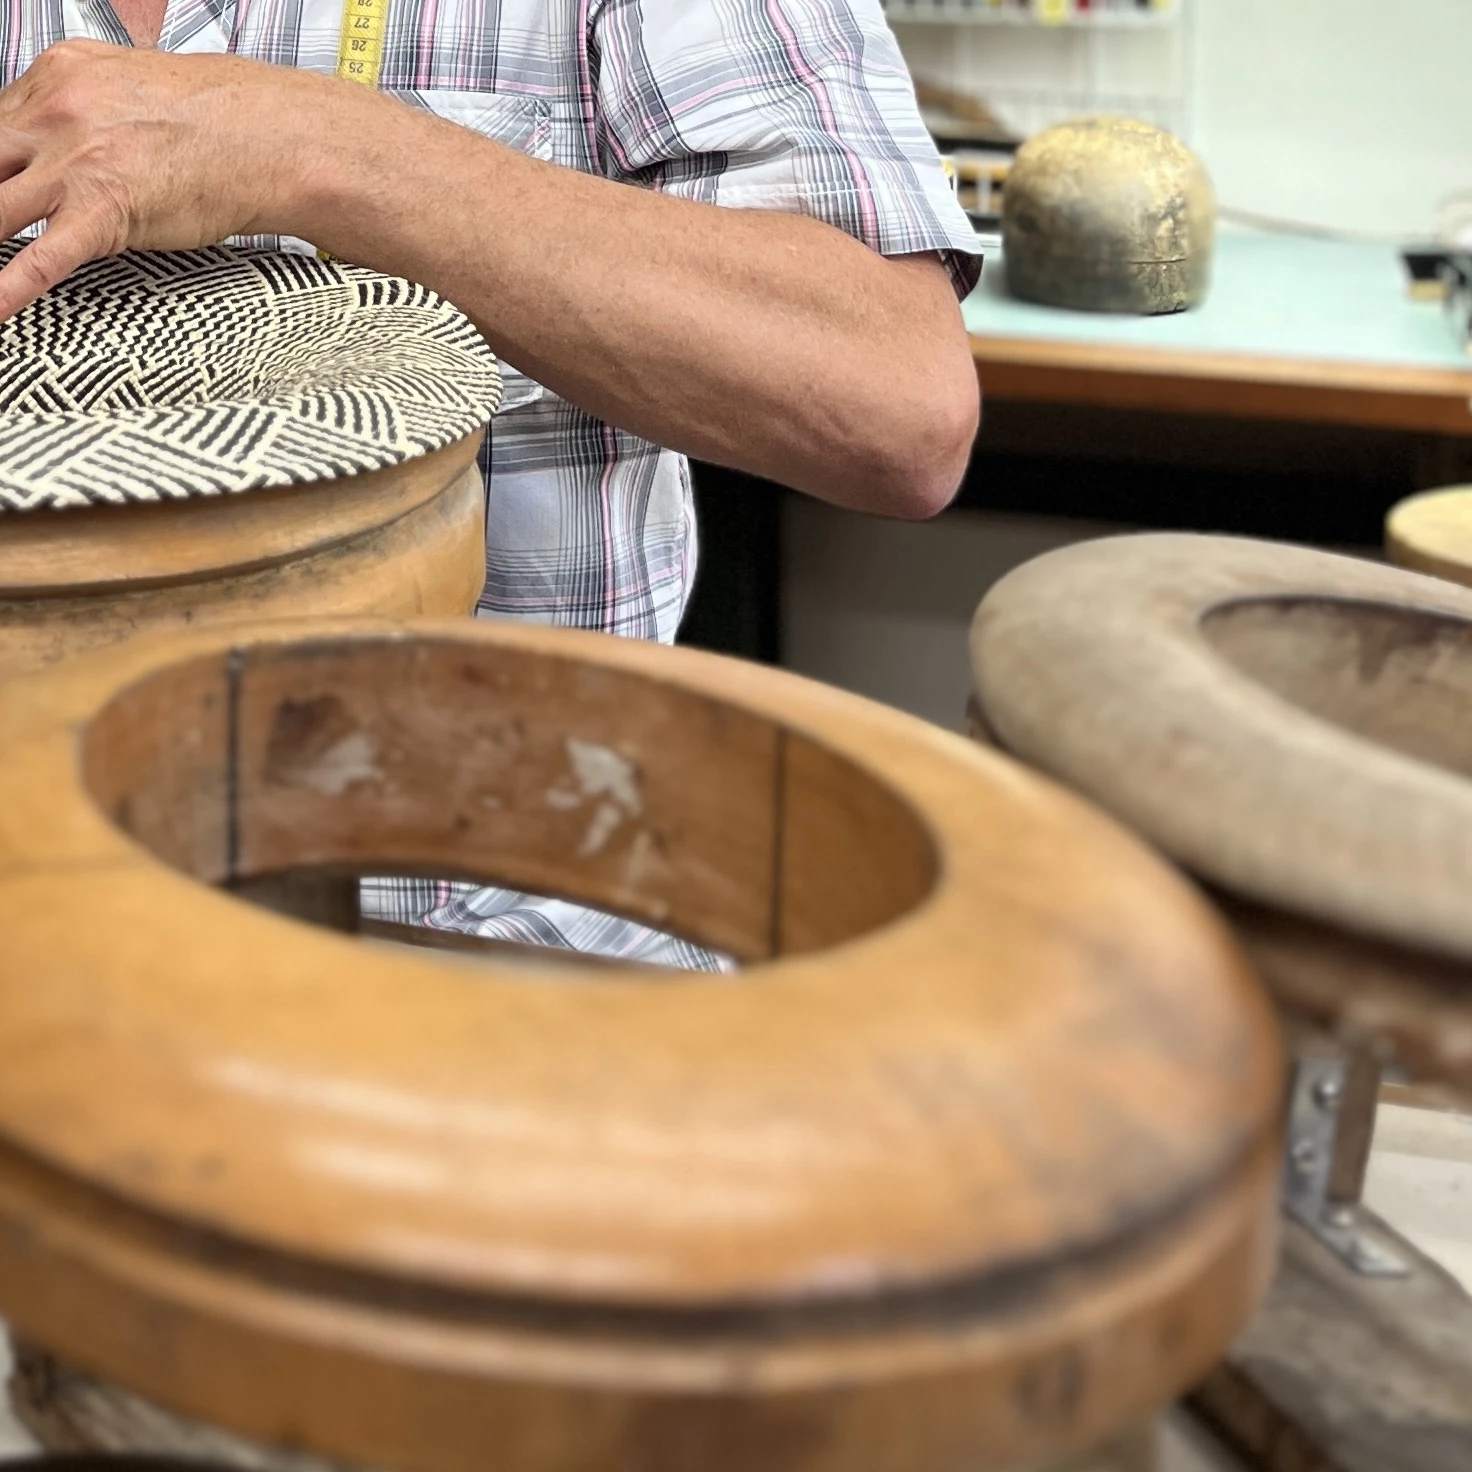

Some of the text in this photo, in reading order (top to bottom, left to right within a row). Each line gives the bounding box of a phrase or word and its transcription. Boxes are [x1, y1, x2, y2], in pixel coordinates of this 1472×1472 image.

[354, 17, 370, 29] 27
[351, 39, 368, 52] 26
[348, 61, 364, 74] 25
